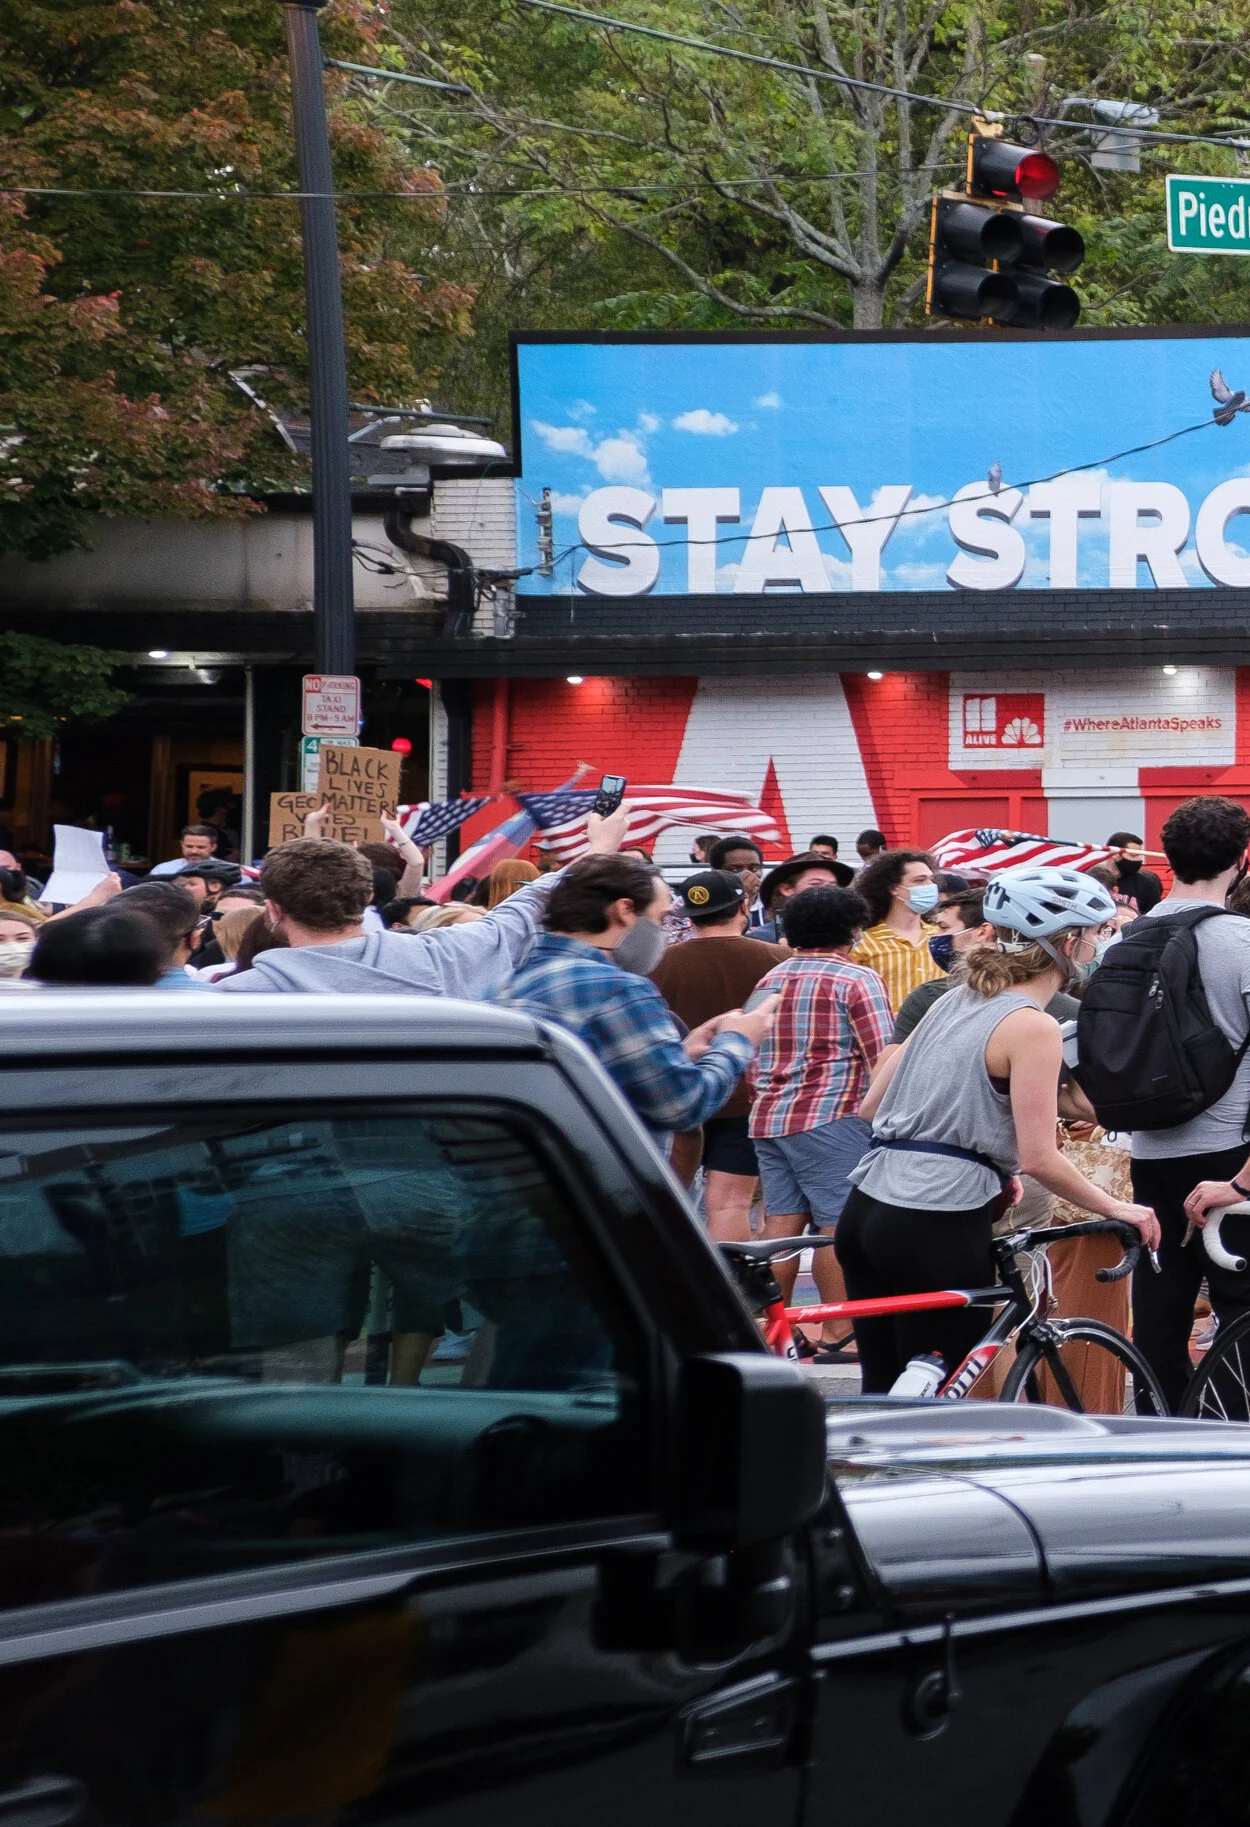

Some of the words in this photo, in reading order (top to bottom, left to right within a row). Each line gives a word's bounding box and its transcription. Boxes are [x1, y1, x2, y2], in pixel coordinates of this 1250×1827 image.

[576, 485, 913, 596] STAY
[305, 678, 320, 691] NO
[316, 704, 346, 712] STAND
[1063, 716, 1222, 733] #WhereAtlantaSpeaks
[965, 733, 997, 746] ALIVE
[326, 750, 390, 780] BLACK
[329, 777, 388, 798] LIVES
